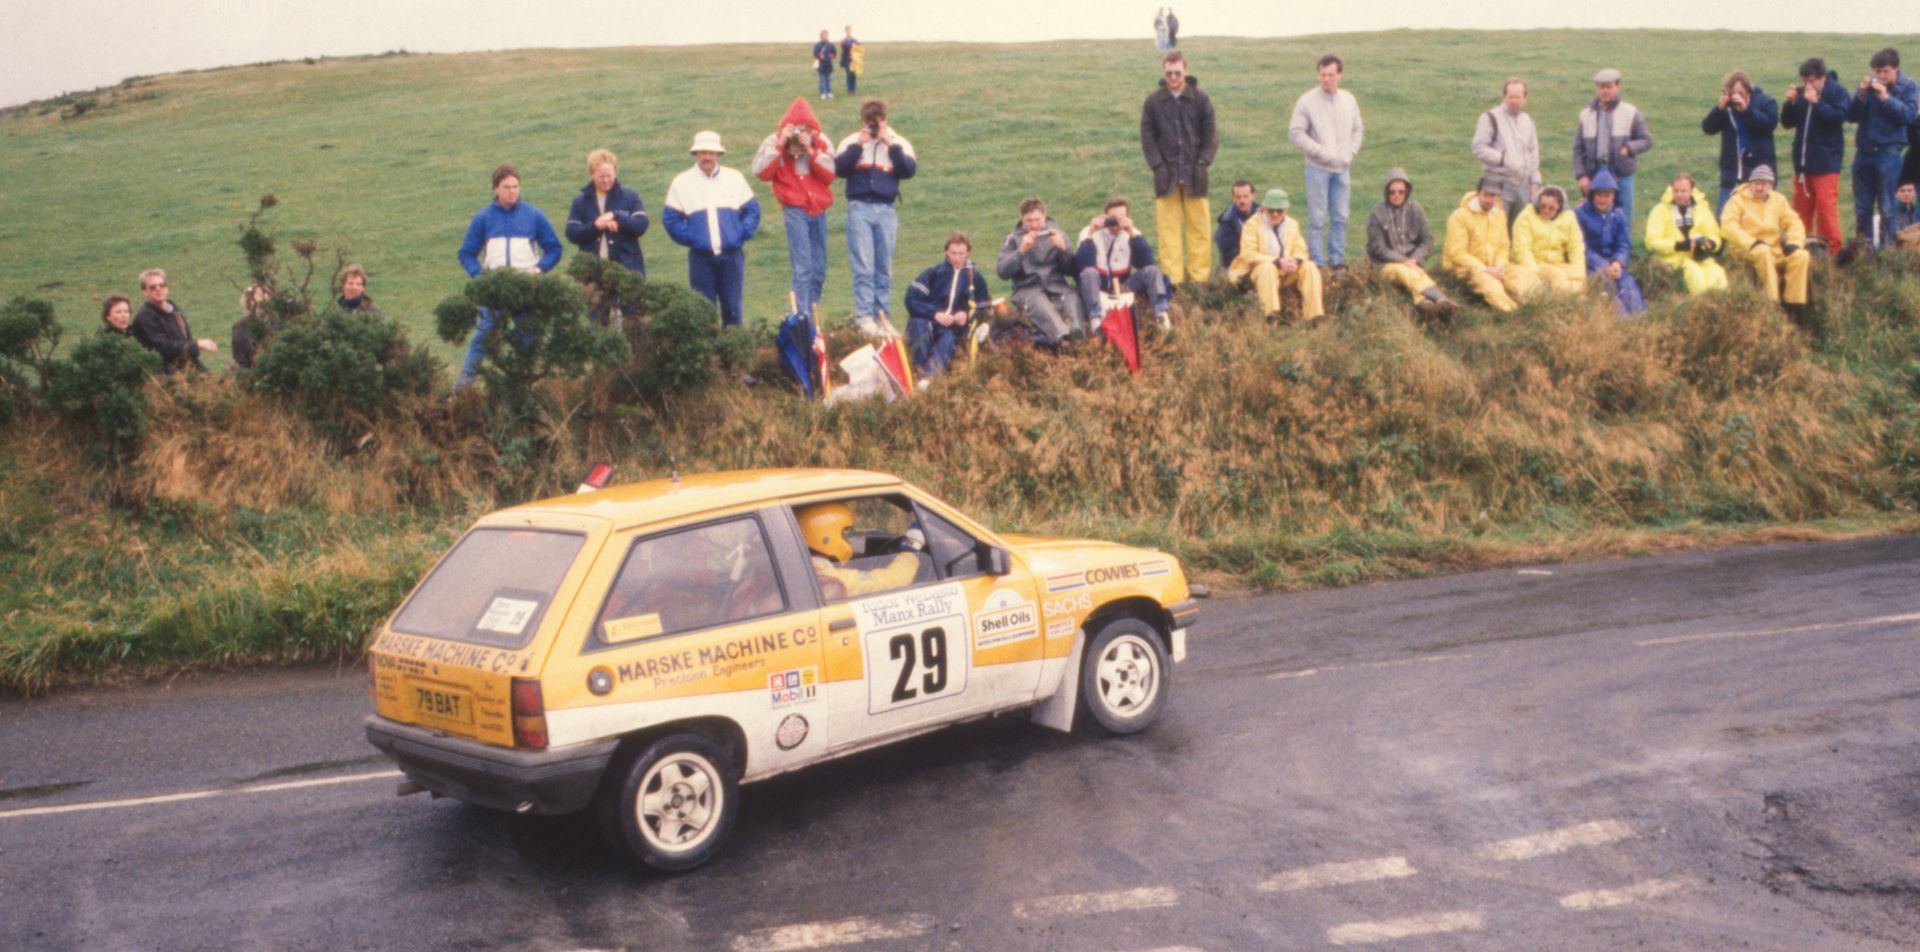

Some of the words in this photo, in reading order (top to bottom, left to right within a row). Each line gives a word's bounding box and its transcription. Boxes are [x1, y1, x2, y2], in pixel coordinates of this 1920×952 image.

[1085, 563, 1140, 585] COWIES
[873, 610, 913, 627] Manx
[917, 600, 953, 618] Rally
[1043, 594, 1092, 617] SACHS
[981, 616, 1008, 632] Shell
[1010, 611, 1031, 625] Oils
[425, 644, 491, 670] MACHINE
[618, 651, 694, 683] MARSKE
[698, 632, 788, 665] MACHINE
[889, 626, 947, 703] 29
[653, 668, 707, 689] Precision
[712, 658, 766, 676] Engineers
[415, 687, 433, 712] 79
[434, 691, 460, 717] BAT
[772, 687, 804, 705] Mobil
